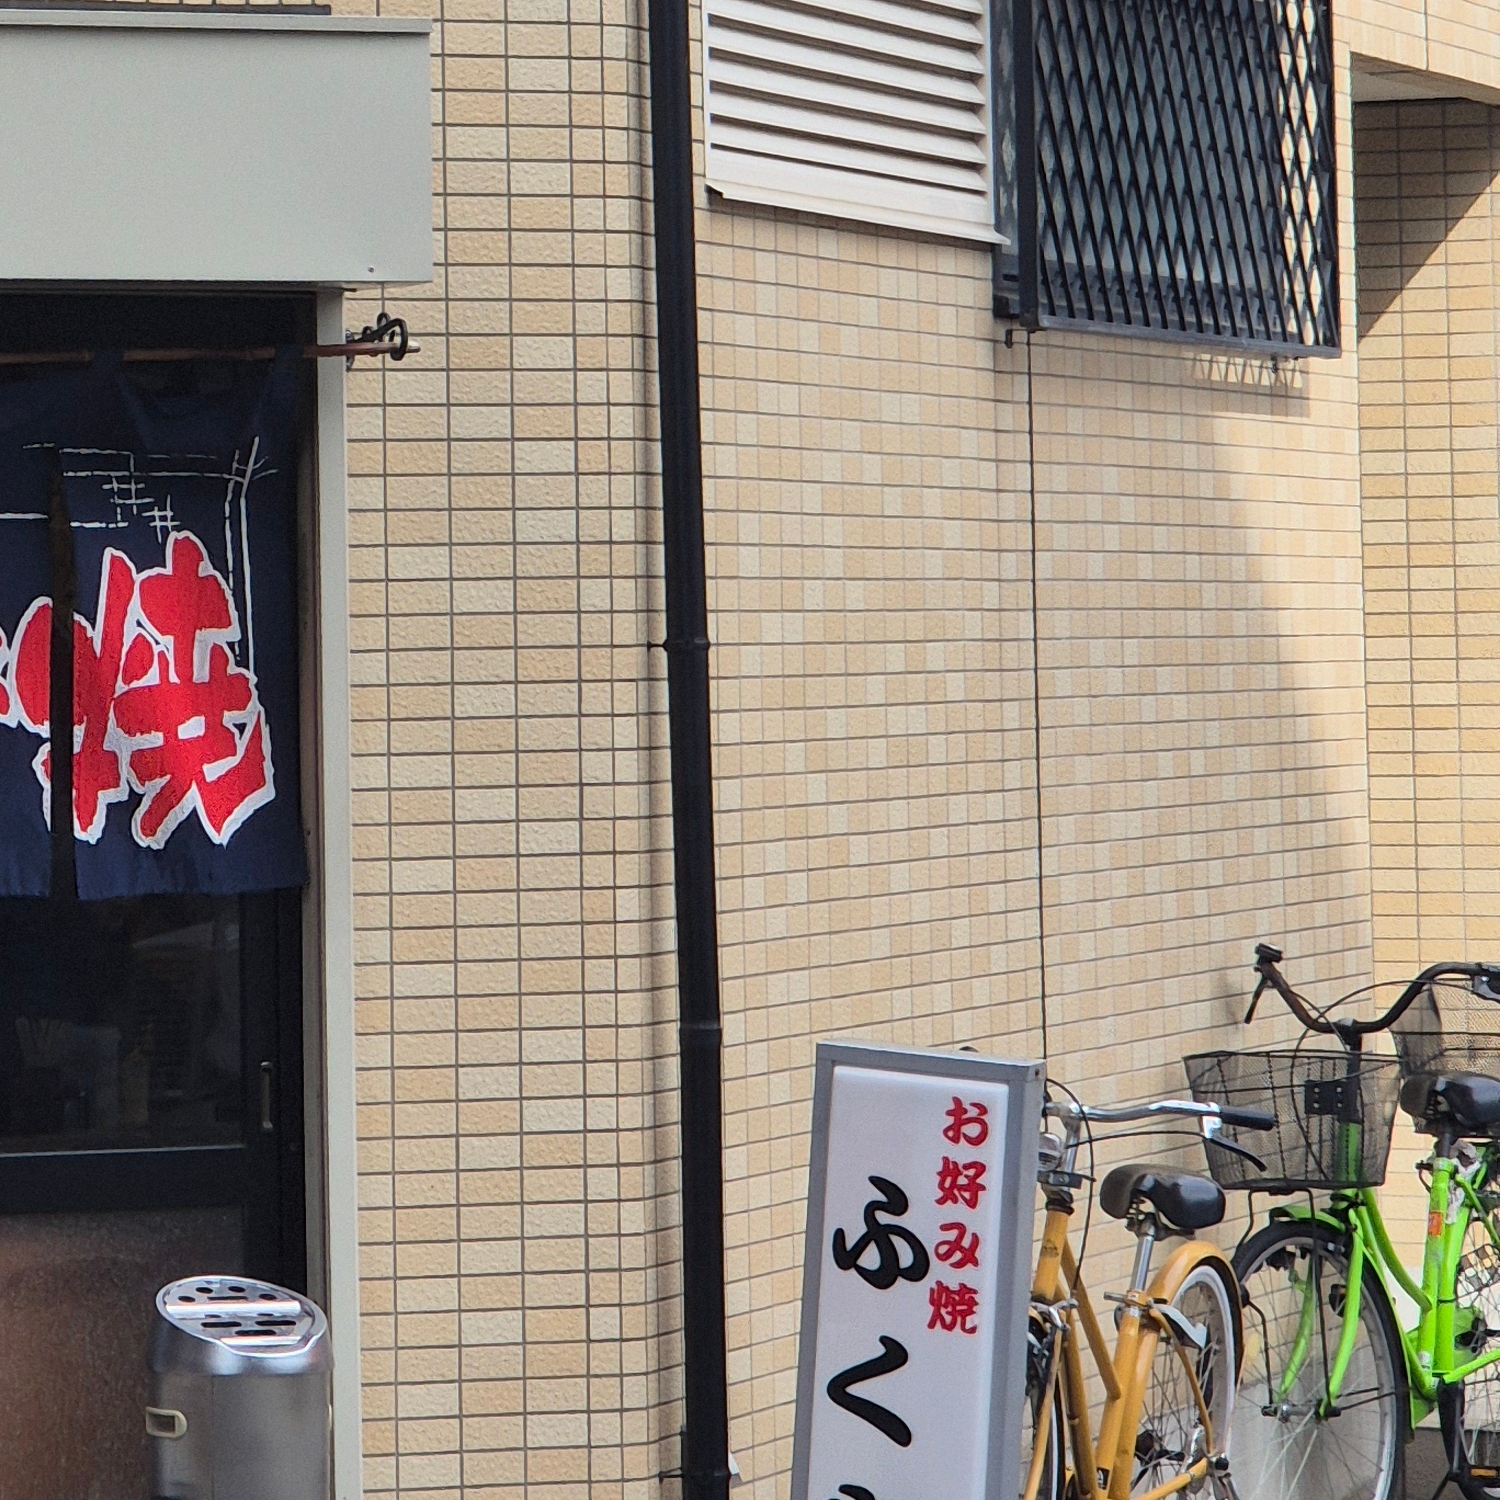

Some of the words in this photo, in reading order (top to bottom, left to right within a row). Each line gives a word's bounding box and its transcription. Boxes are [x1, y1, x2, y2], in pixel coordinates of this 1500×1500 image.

[827, 1175, 928, 1500] ふく
[929, 1096, 989, 1335] お好み焼
